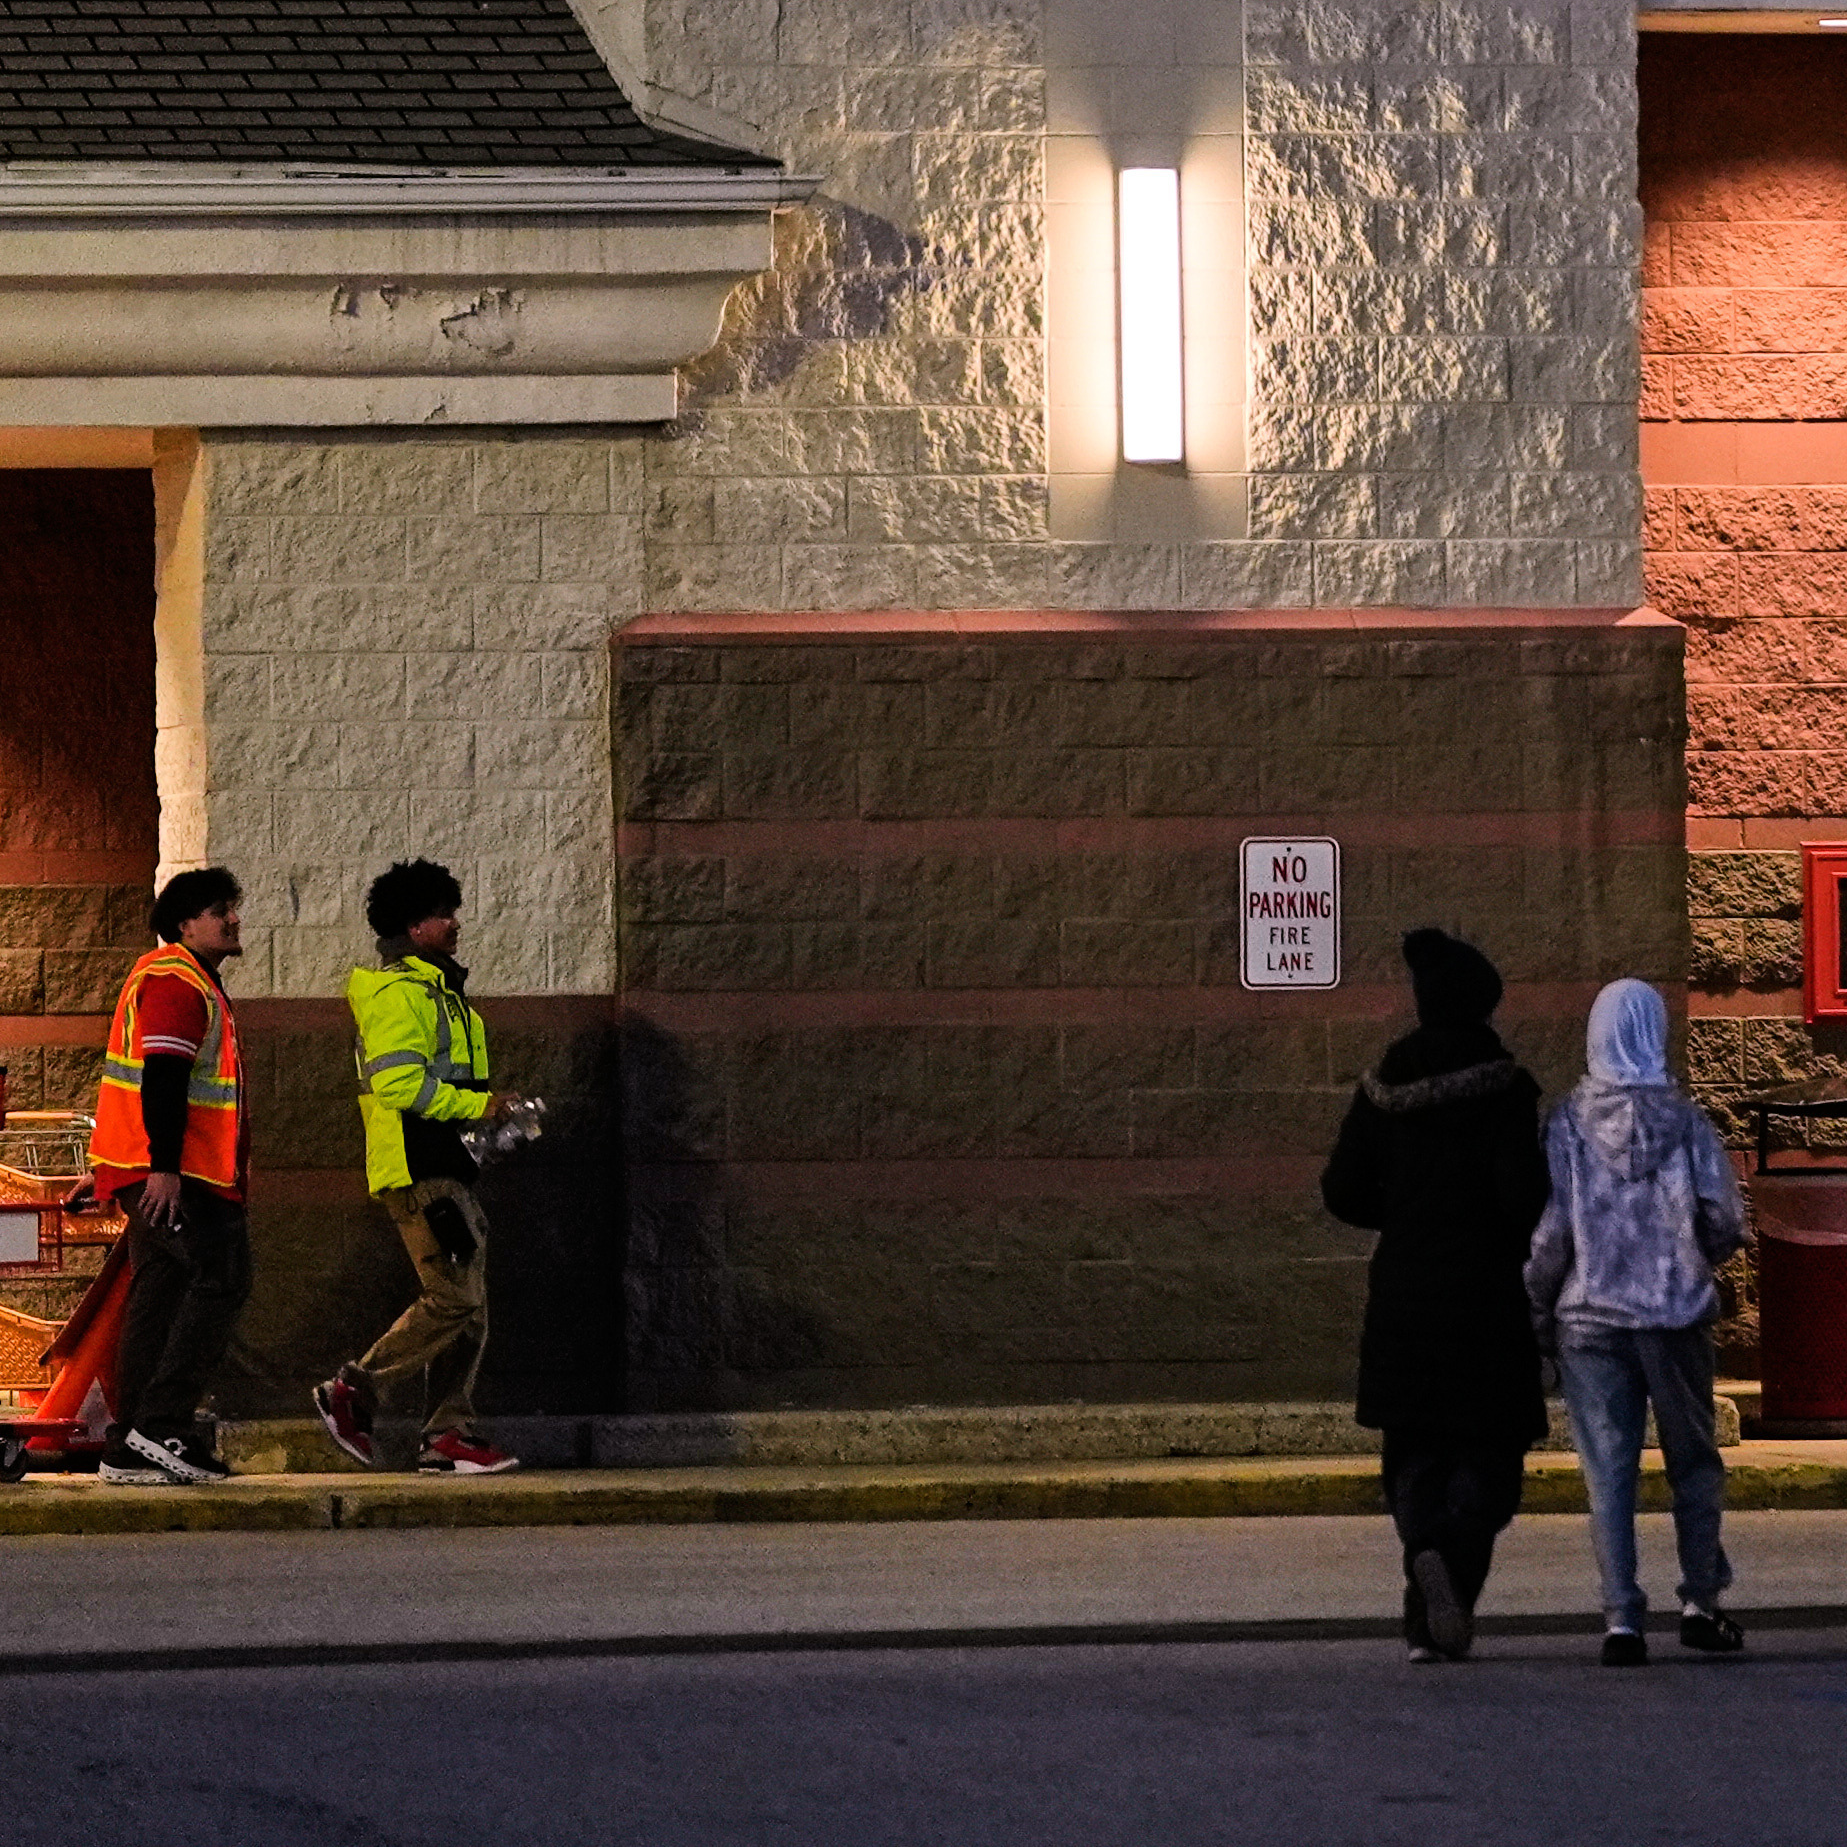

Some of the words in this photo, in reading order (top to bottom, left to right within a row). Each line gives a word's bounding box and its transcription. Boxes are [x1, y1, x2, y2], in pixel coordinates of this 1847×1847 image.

[1272, 855, 1307, 883] NO
[1249, 891, 1331, 919] PARKING
[1269, 926, 1311, 945] FIRE
[1267, 952, 1314, 971] LANE
